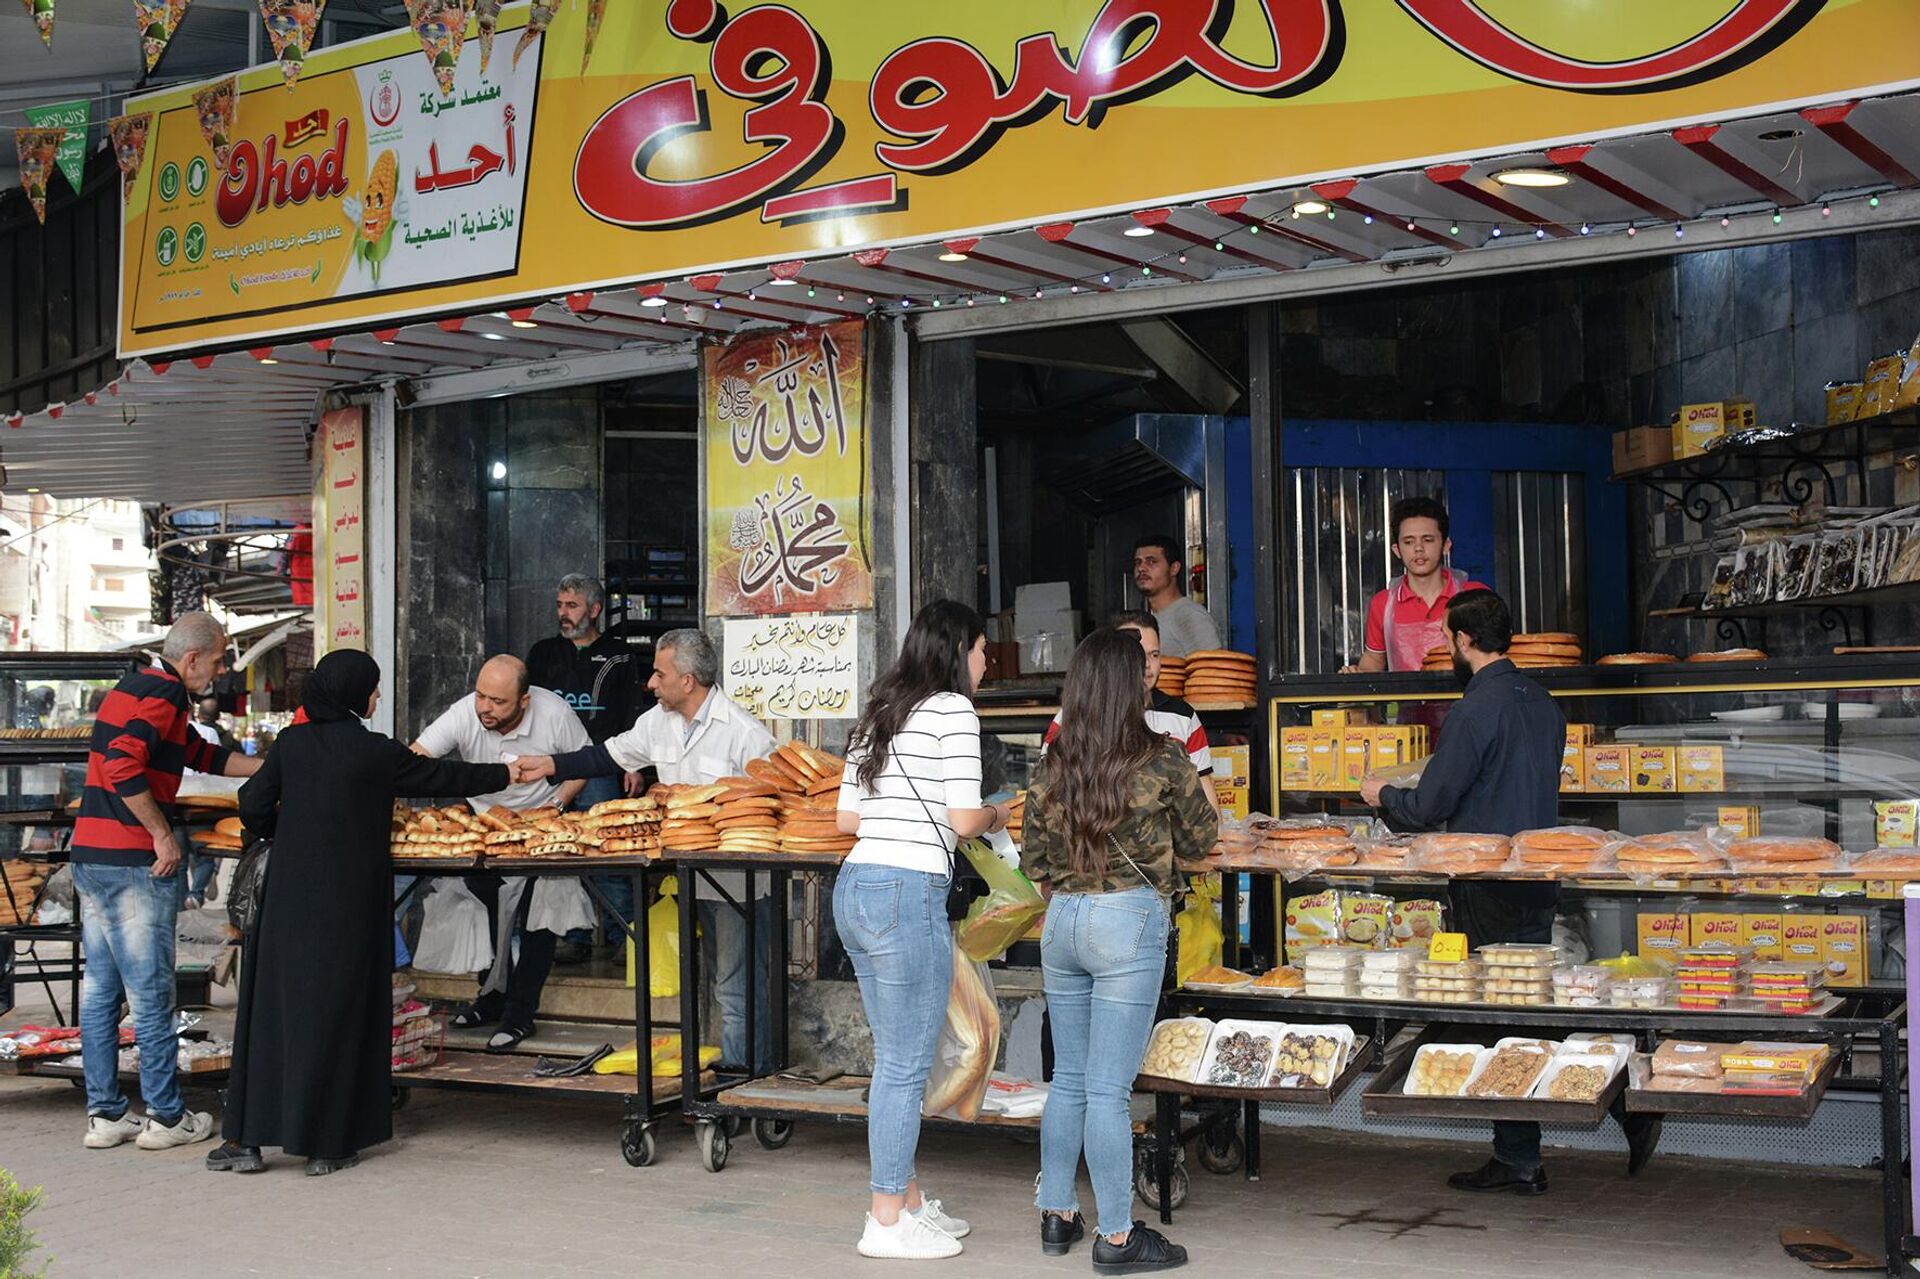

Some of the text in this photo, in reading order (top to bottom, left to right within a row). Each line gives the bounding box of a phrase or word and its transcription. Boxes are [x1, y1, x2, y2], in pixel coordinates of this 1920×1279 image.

[420, 83, 456, 117] شركة
[415, 104, 516, 194] أحد
[216, 117, 349, 228] Ohod
[404, 206, 514, 249] للأغذية الصحية
[730, 657, 763, 679] المبارك
[815, 655, 851, 677] بمناسبة
[768, 677, 797, 718] كريم
[1353, 902, 1384, 915] Ohod
[1652, 919, 1684, 931] Ohod
[1704, 921, 1738, 934] Ohod
[1751, 919, 1780, 931] Ohod
[1784, 926, 1818, 939] Ohod
[1824, 922, 1858, 935] Ohod
